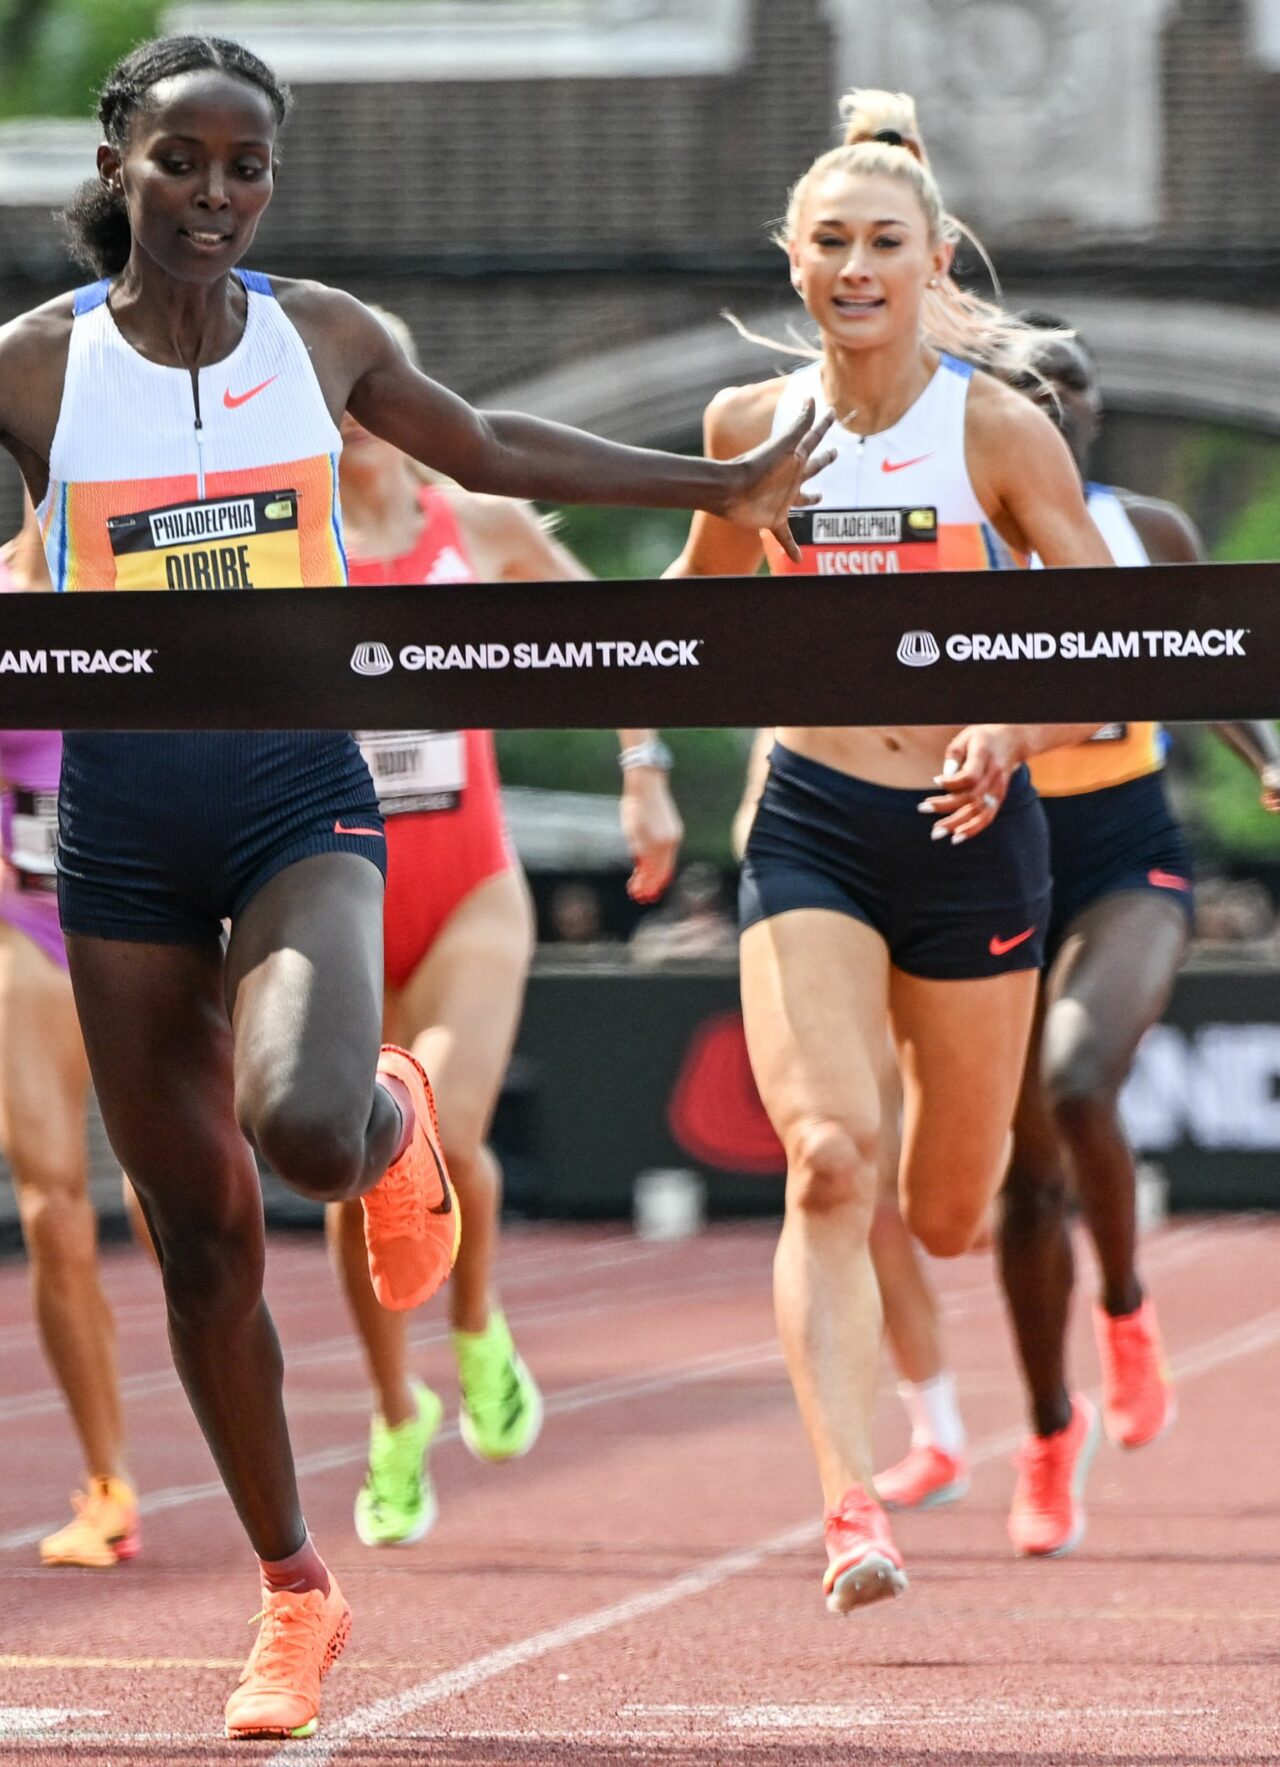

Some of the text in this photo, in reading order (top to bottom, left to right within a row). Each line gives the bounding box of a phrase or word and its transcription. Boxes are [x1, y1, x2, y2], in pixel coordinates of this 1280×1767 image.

[154, 504, 253, 540] PHILADELPHIA
[816, 516, 897, 538] PHILADELPHIA
[399, 639, 700, 671] GRAND SLAM TRACK
[945, 628, 1246, 662] GRAND SLAM TRACK
[49, 649, 154, 674] TRACK
